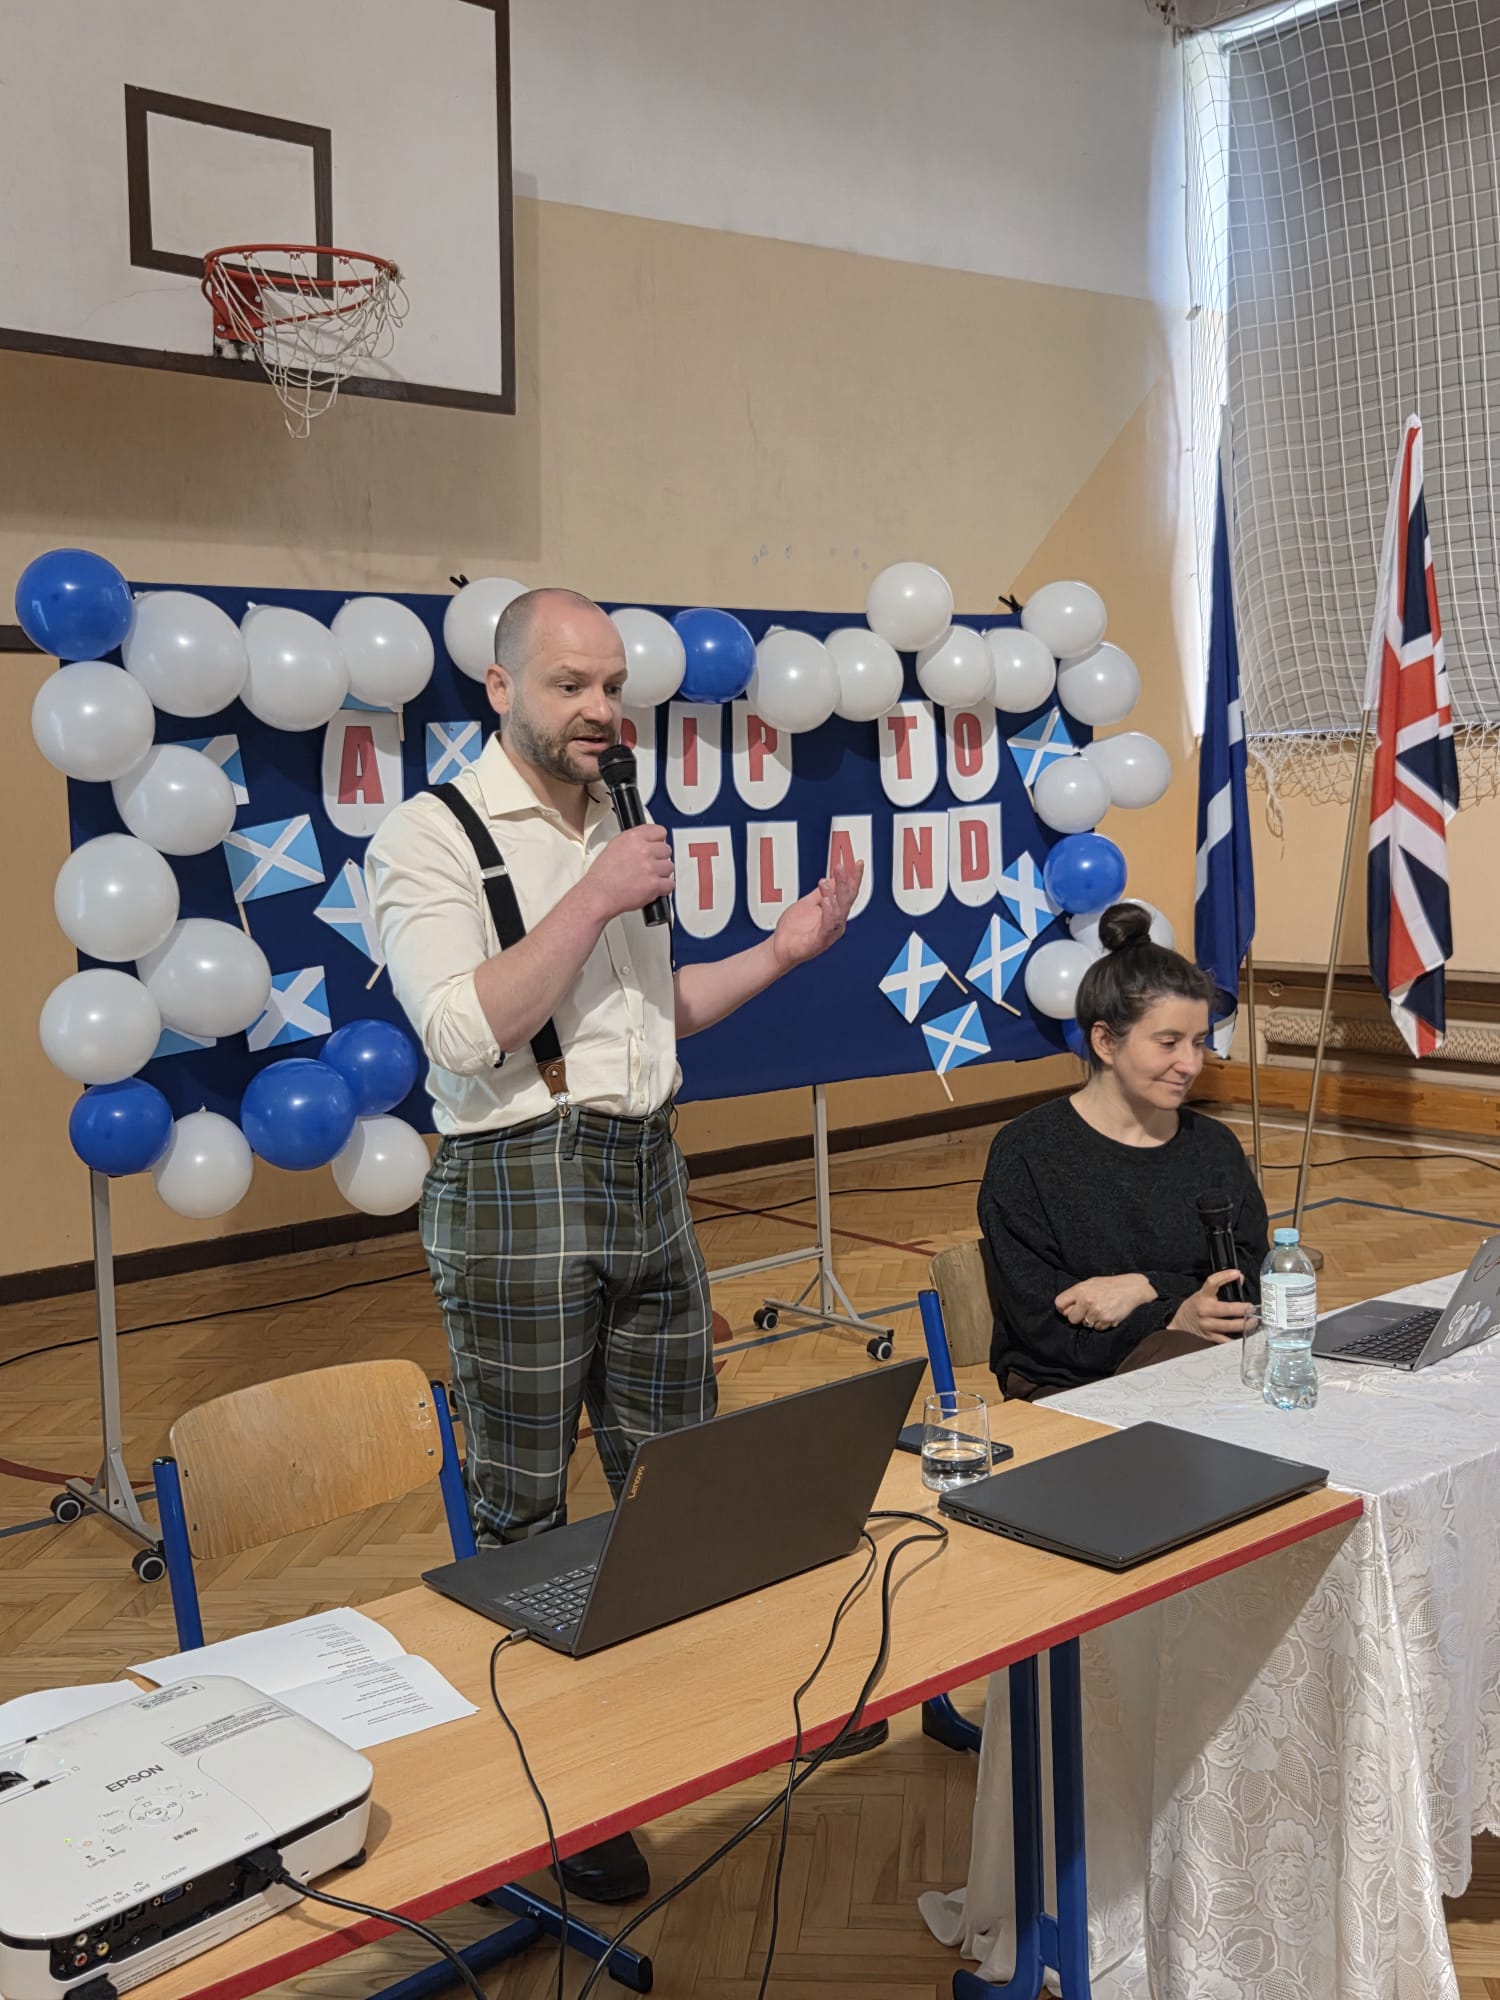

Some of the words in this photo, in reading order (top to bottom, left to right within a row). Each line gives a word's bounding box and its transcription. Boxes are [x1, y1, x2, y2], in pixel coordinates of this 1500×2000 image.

[338, 726, 384, 804] A
[887, 712, 984, 780] TO
[627, 1465, 645, 1499] Lenovo
[105, 1764, 164, 1793] EPSON
